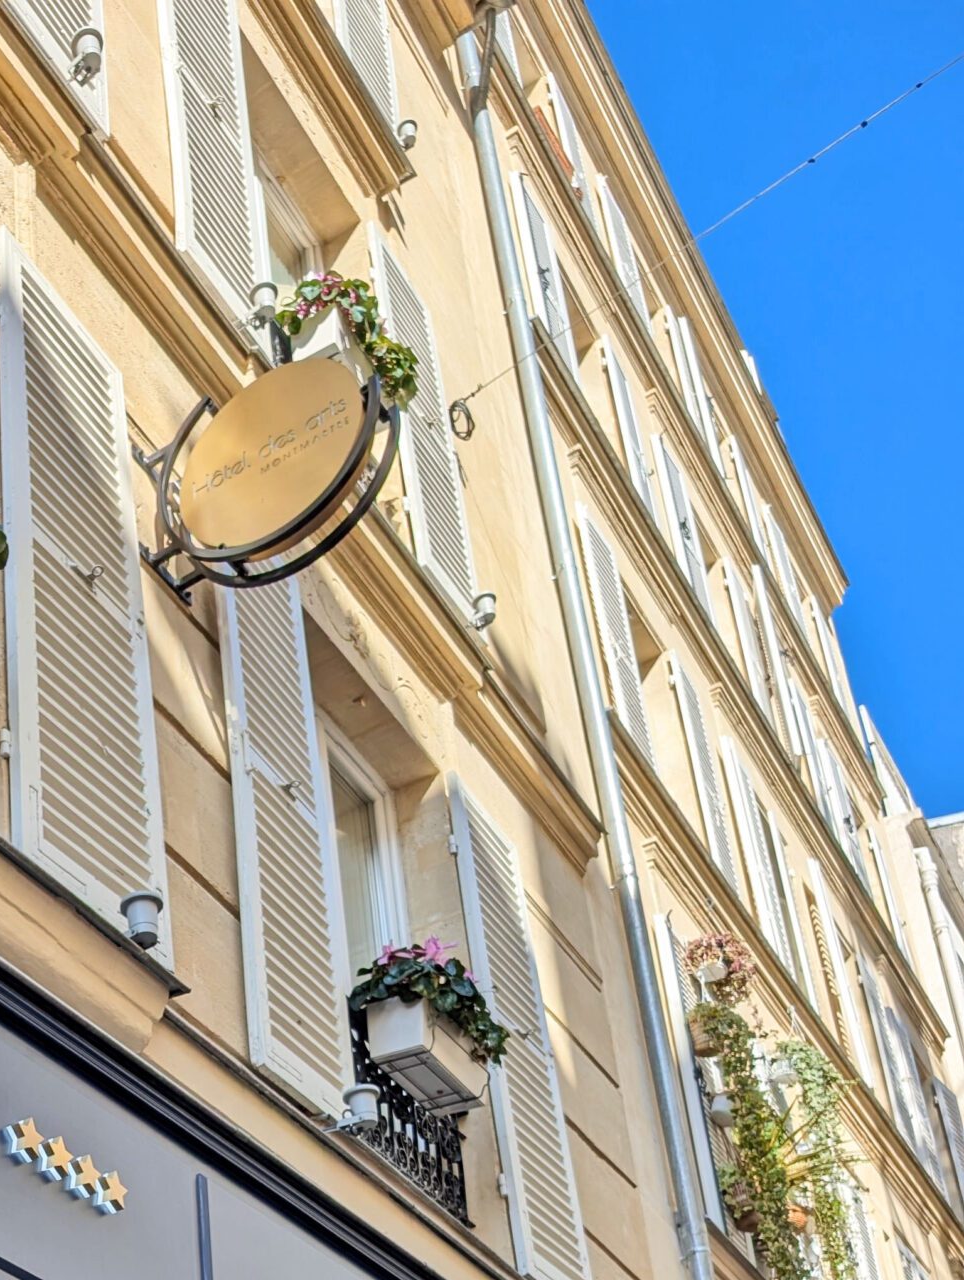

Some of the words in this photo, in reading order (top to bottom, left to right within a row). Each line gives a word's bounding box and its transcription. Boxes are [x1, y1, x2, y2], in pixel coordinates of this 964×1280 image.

[192, 451, 251, 499] Hôtel
[259, 429, 297, 459] des
[305, 398, 348, 431] arts
